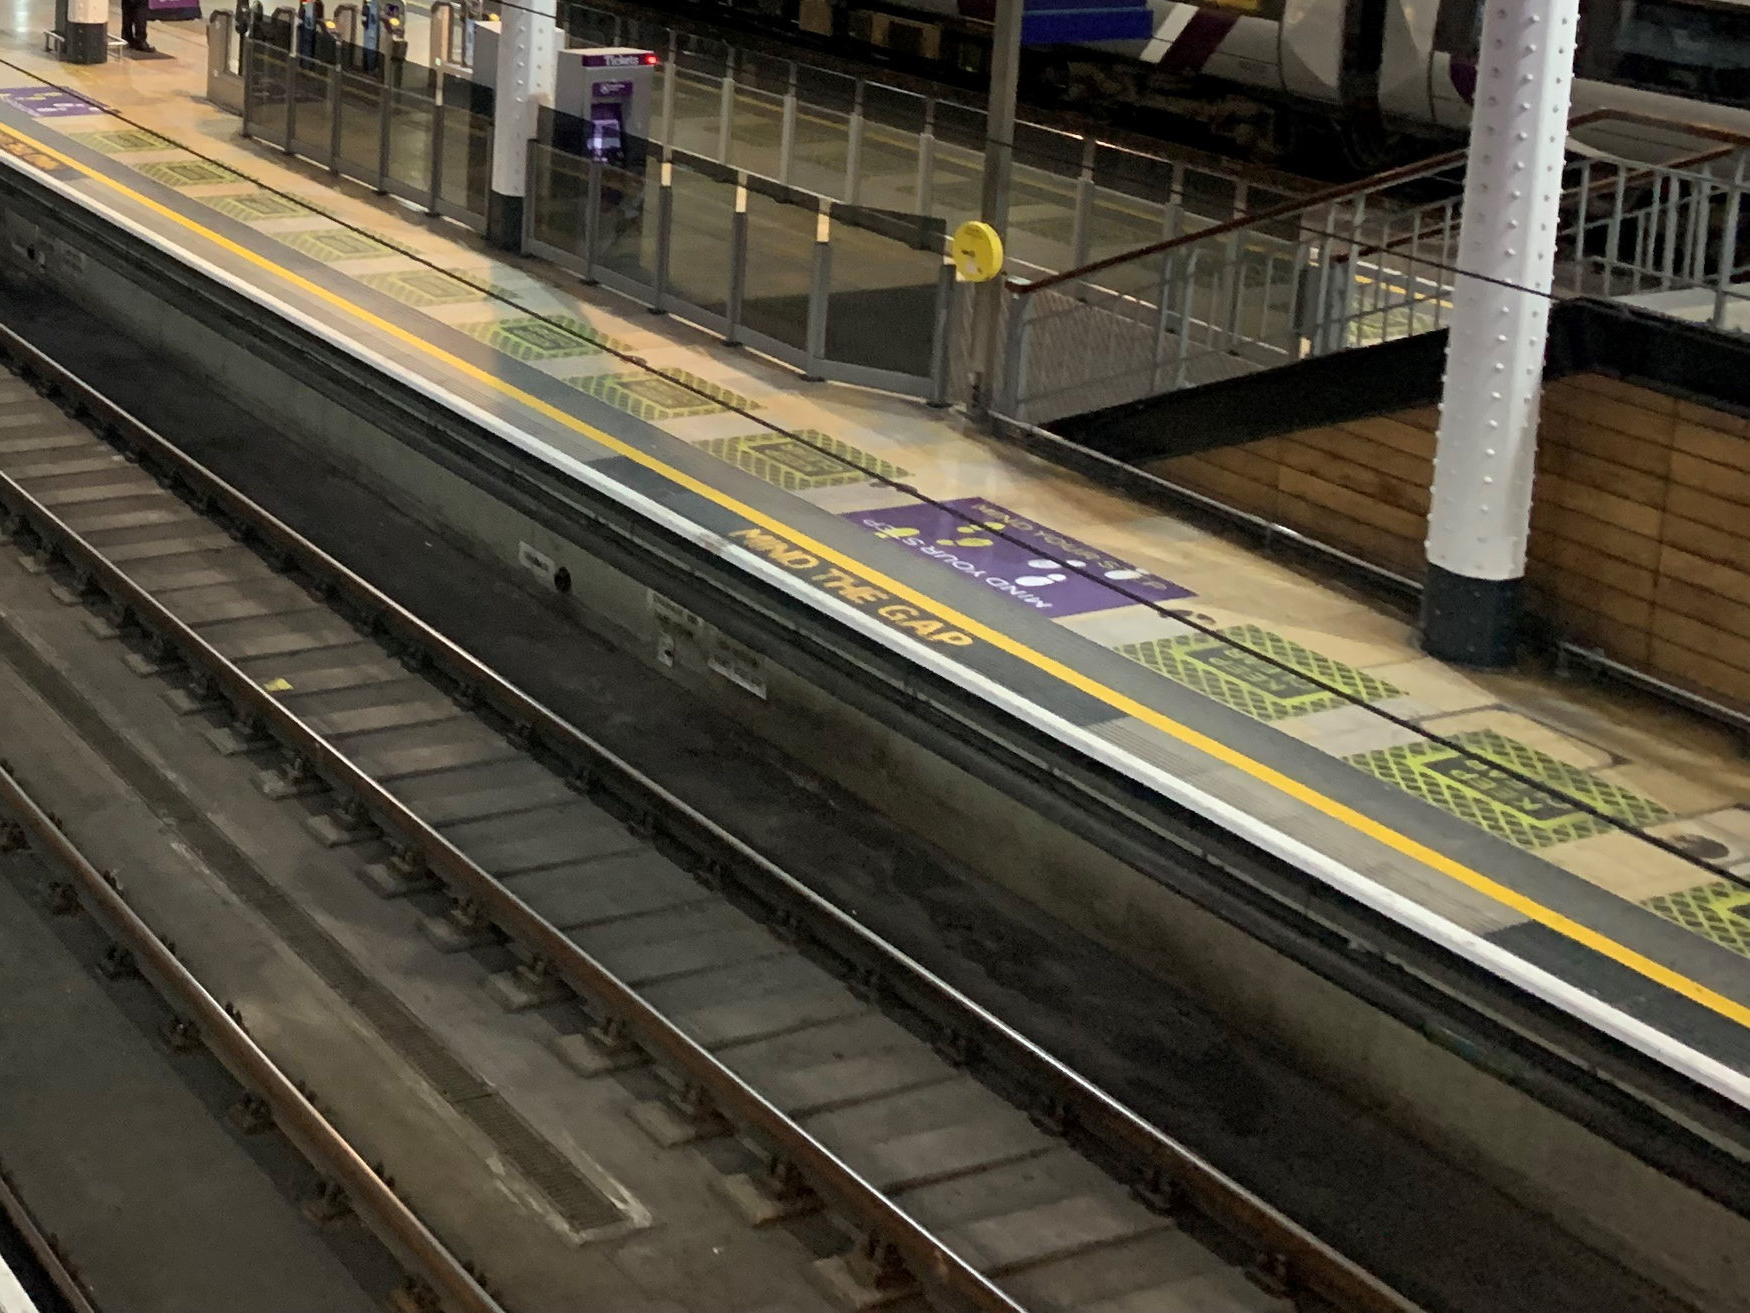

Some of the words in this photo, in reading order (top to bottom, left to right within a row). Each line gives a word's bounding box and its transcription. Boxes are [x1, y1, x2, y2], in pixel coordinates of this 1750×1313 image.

[920, 546, 986, 577] YOUR
[729, 528, 821, 569] MIND
[812, 568, 890, 604] THE
[878, 605, 974, 646] GAP
[985, 577, 1053, 608] MIND
